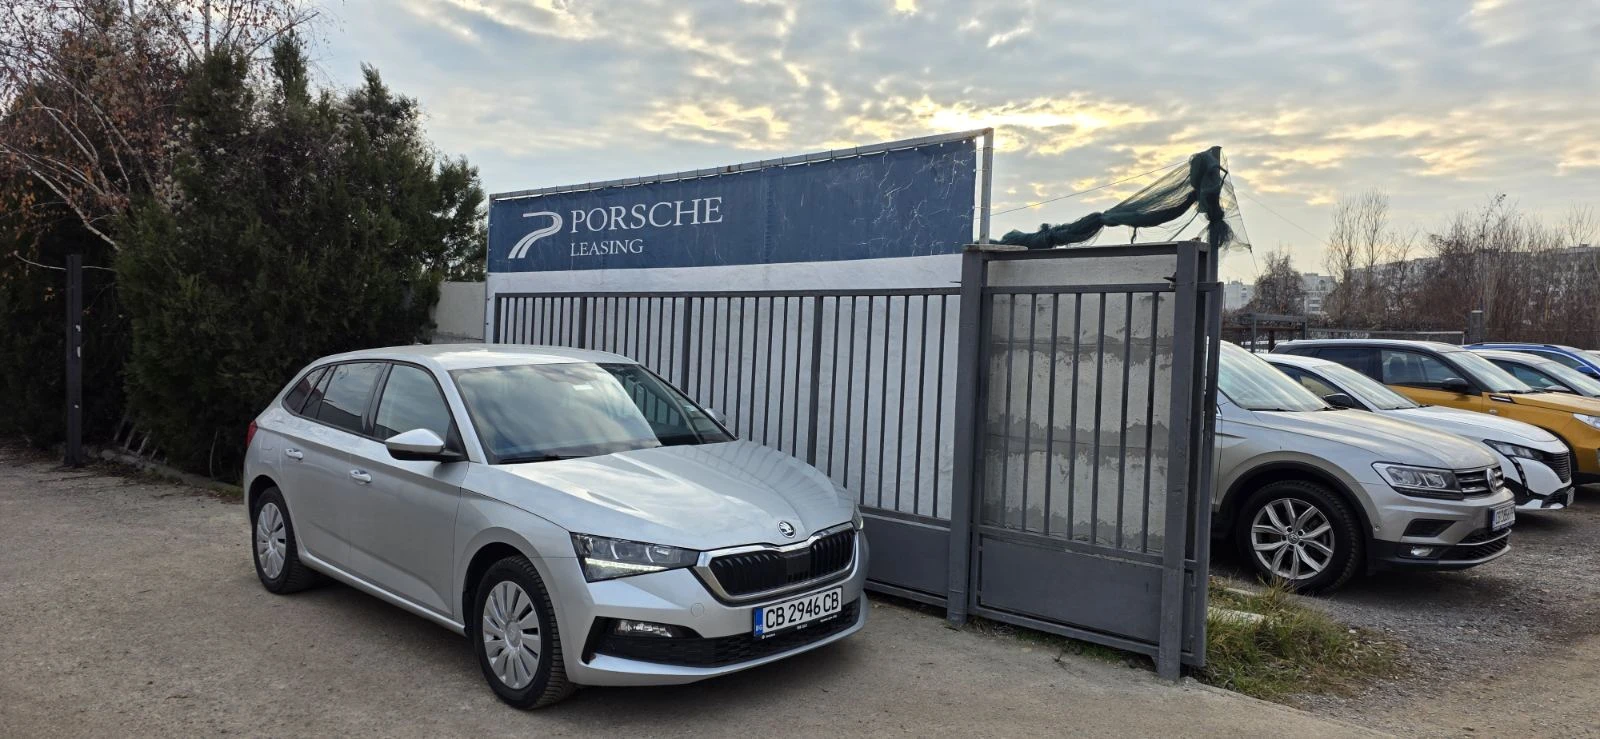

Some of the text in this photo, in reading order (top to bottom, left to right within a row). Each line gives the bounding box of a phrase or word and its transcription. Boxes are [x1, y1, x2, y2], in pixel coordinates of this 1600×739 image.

[571, 197, 723, 233] PORSCHE
[571, 239, 644, 256] LEASING
[766, 607, 785, 628] CB
[788, 597, 820, 623] 2946
[824, 592, 838, 612] CB
